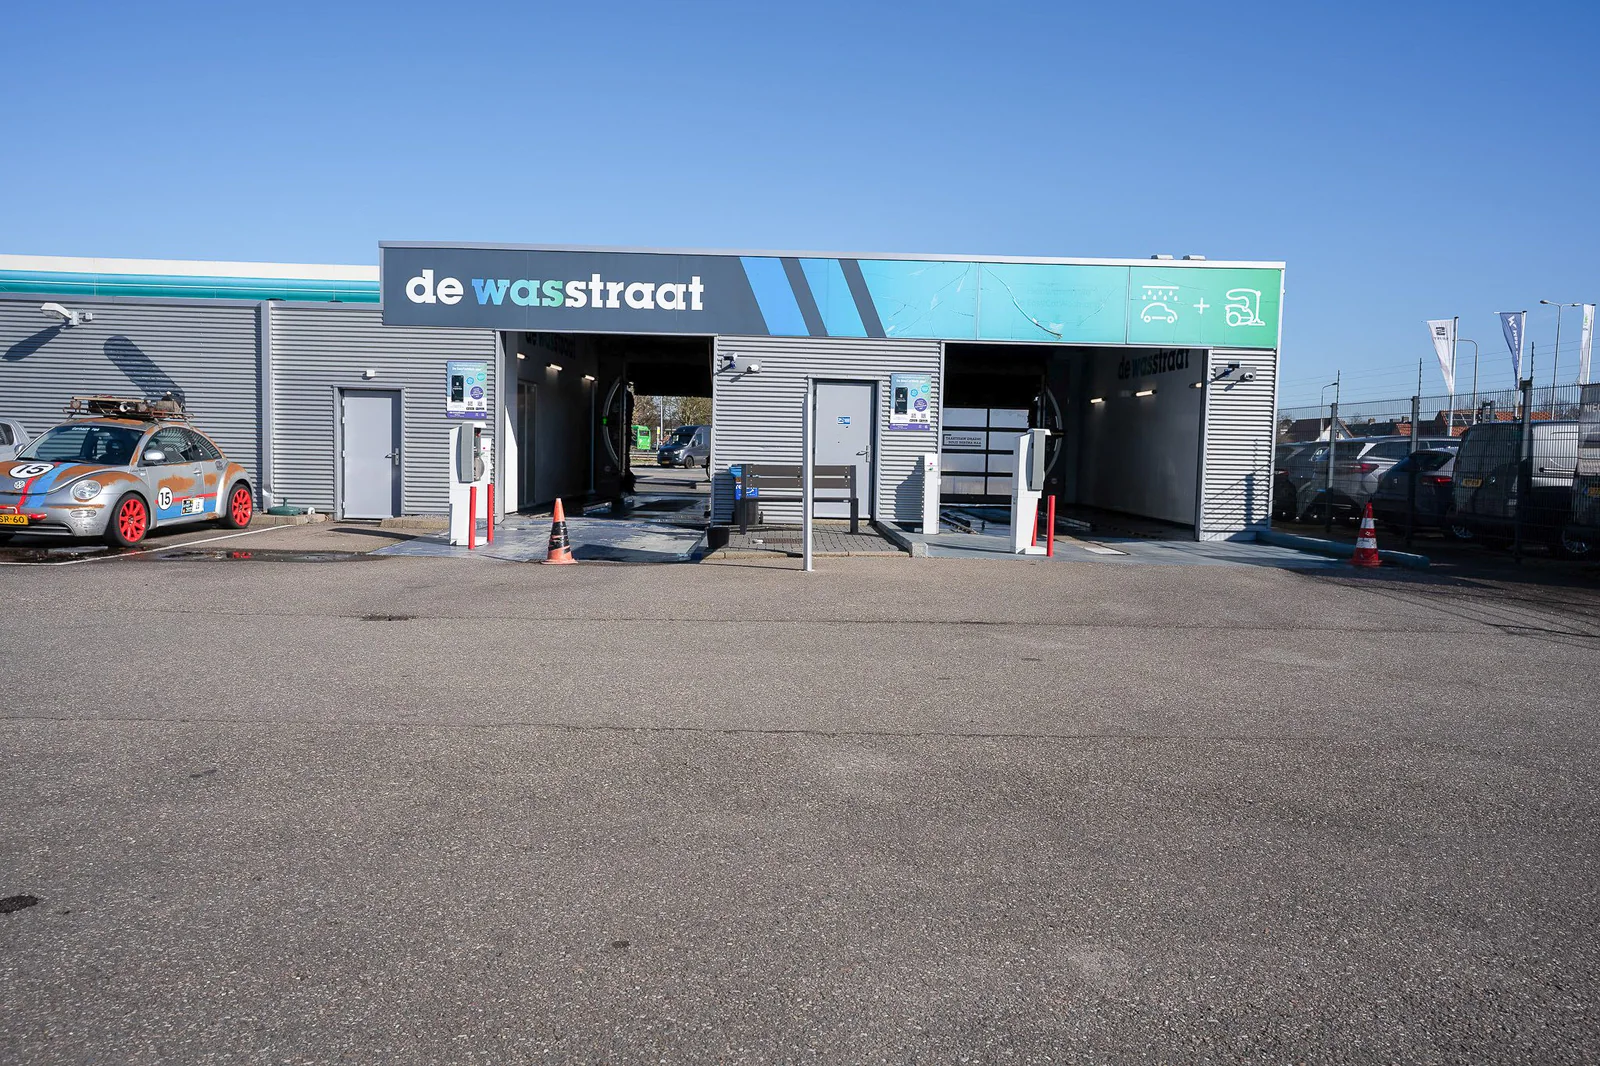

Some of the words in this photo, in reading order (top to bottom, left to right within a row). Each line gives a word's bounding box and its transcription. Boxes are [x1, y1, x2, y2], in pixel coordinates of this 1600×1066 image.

[405, 269, 464, 306] de
[472, 273, 704, 311] wasstraat
[1118, 355, 1131, 380] de
[1132, 348, 1190, 378] wasstraat
[16, 464, 49, 475] 15
[160, 491, 171, 506] 15
